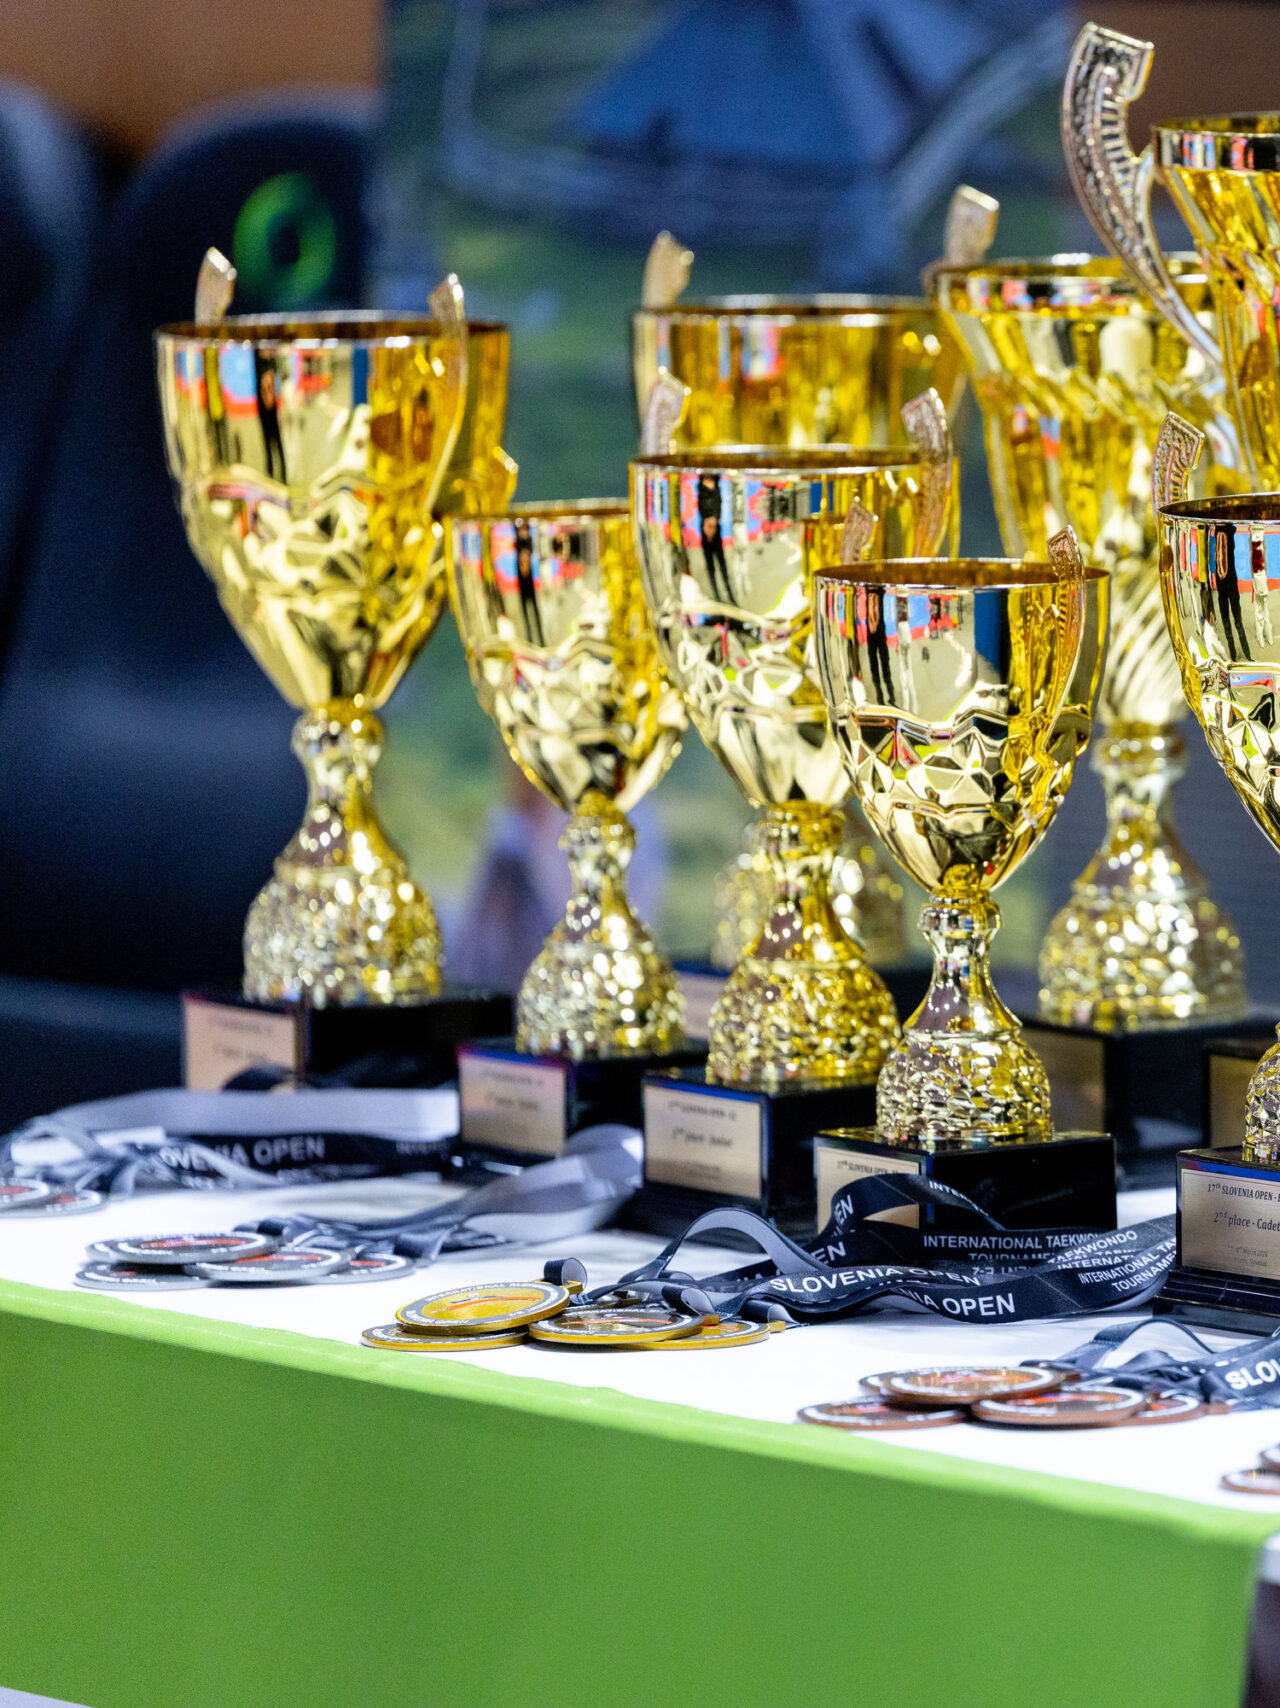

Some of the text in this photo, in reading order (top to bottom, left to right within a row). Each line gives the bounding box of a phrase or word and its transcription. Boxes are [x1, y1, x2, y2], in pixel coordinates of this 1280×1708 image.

[253, 1135, 326, 1167] OPEN
[1222, 1185, 1254, 1199] SLOVENIA
[1255, 1190, 1273, 1201] OPEN
[1228, 1214, 1250, 1228] place
[1256, 1218, 1280, 1232] Cadet
[923, 1235, 1042, 1250] INTERNATIONAL
[769, 1266, 982, 1294] SLOVENIA OPEN
[1077, 1251, 1160, 1285] INTERNATIONAL
[943, 1293, 1016, 1317] OPEN
